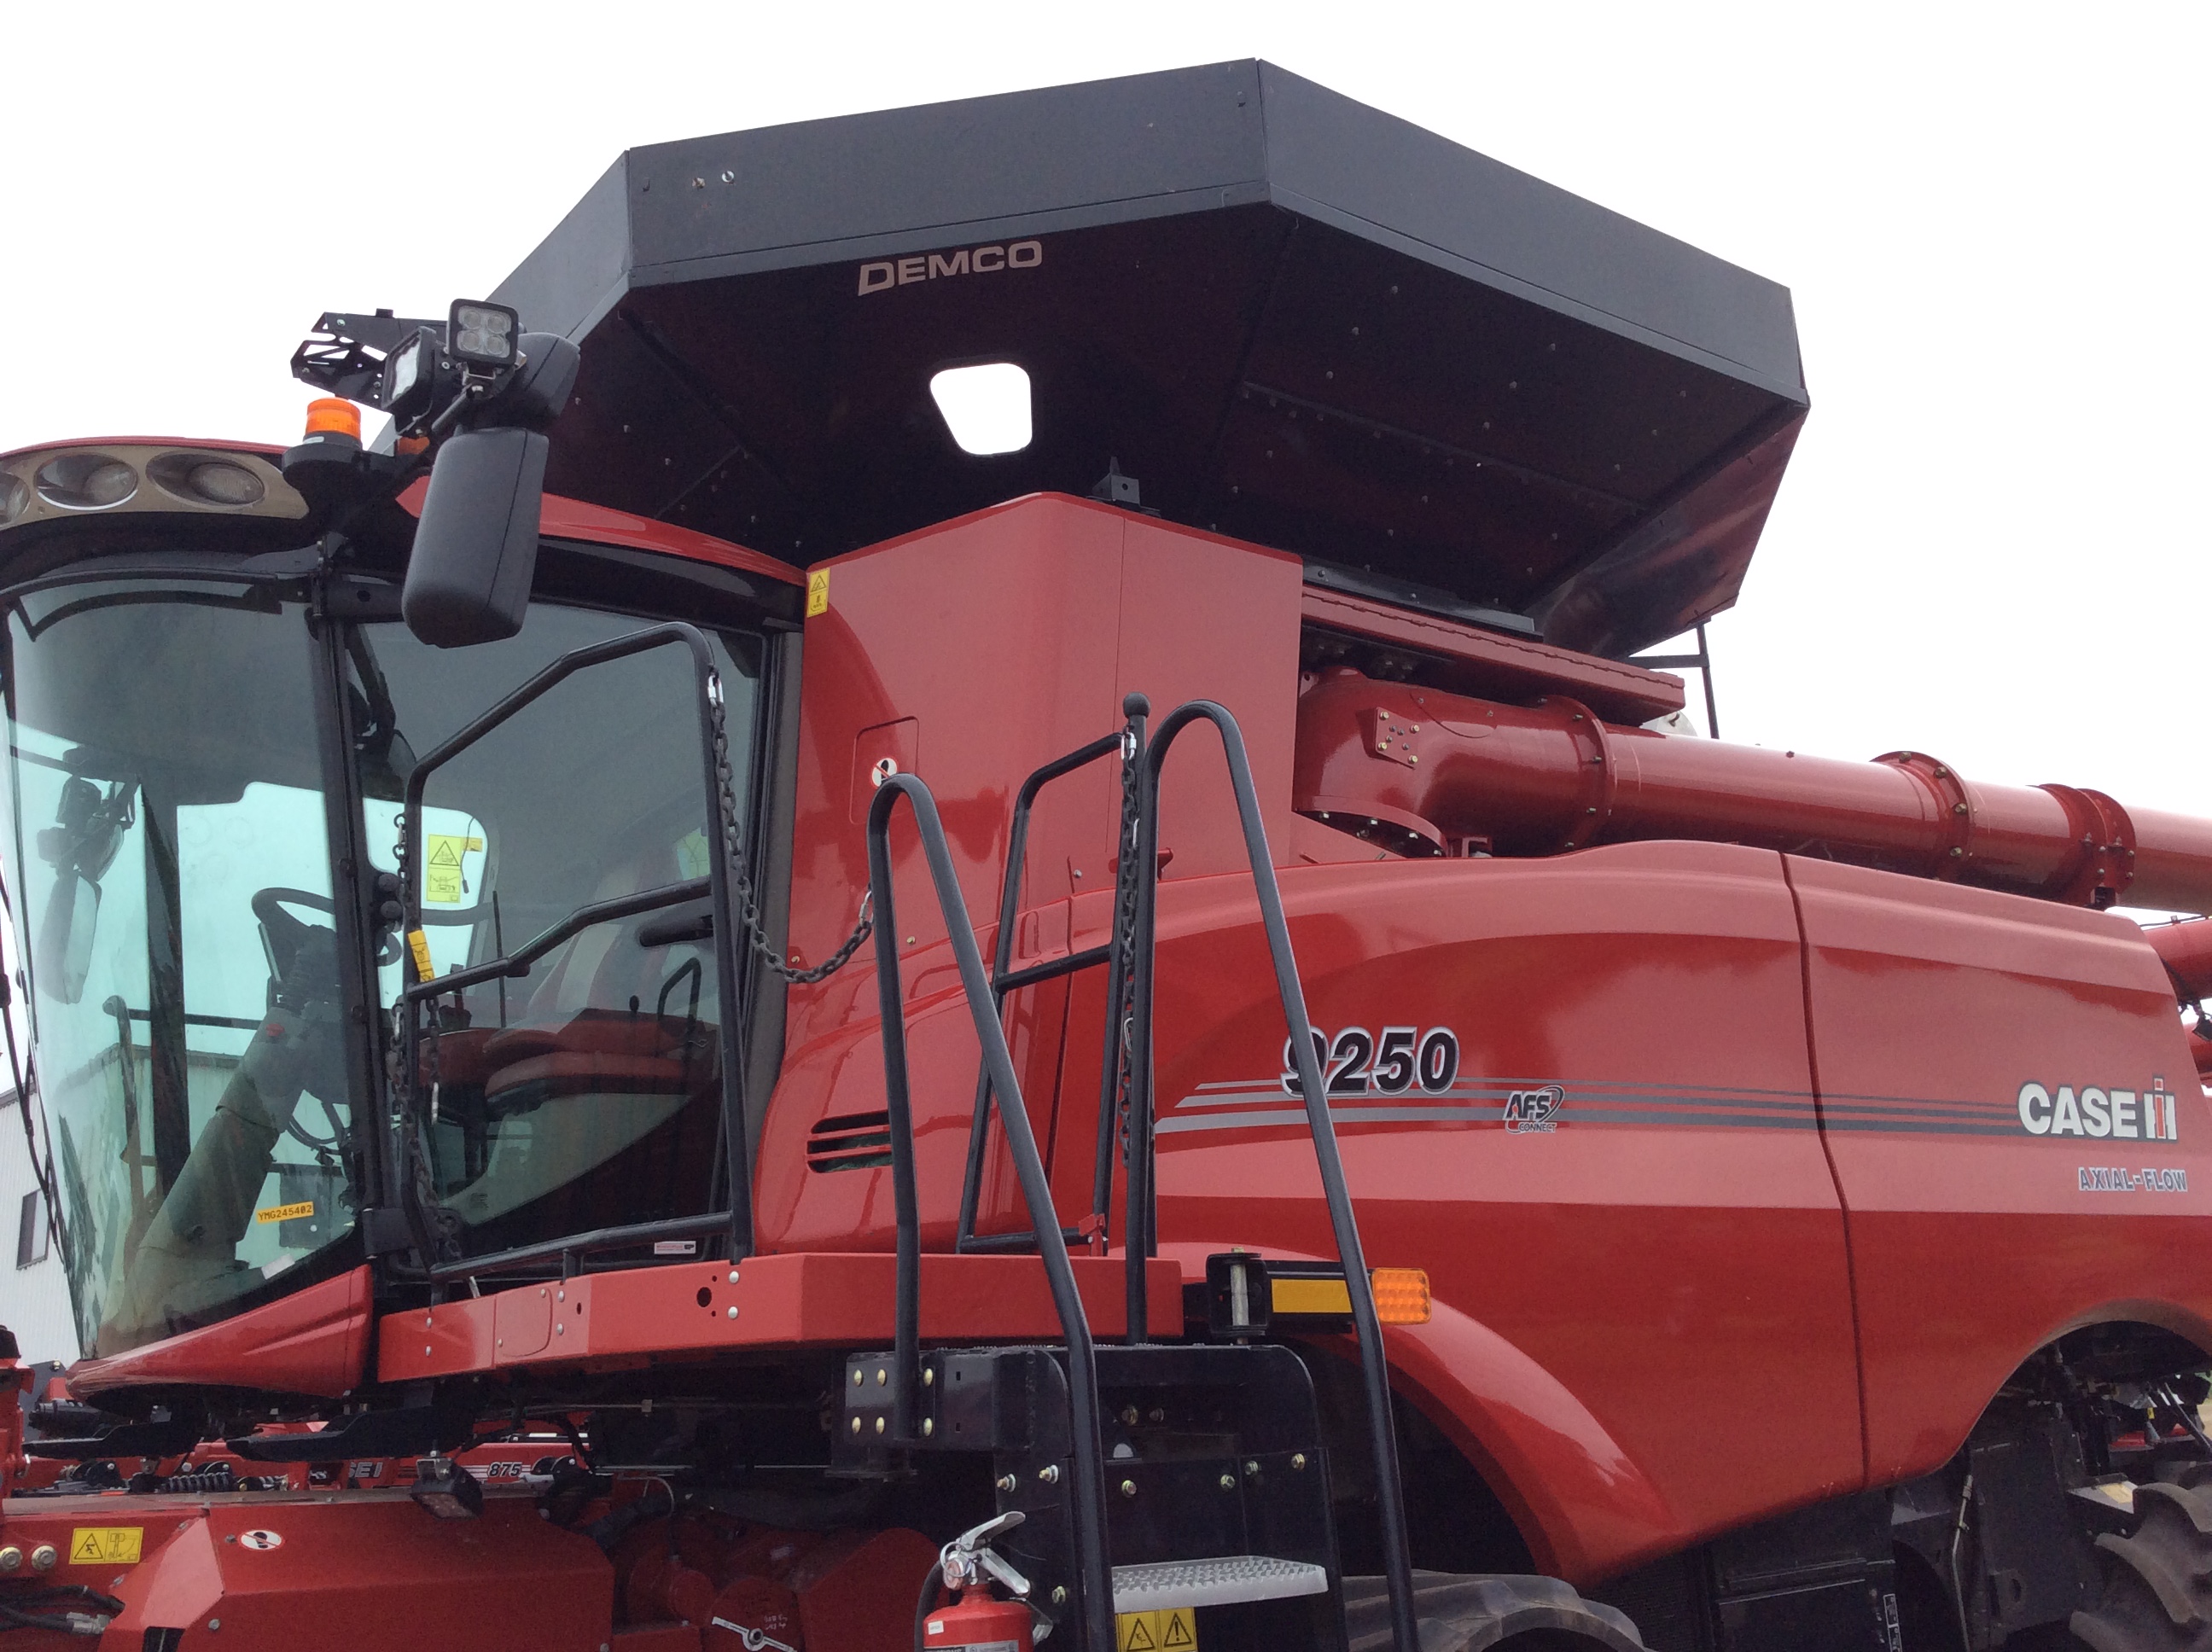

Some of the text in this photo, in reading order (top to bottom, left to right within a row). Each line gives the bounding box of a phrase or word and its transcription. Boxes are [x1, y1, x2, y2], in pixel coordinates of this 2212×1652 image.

[858, 241, 1042, 296] DEMCO
[1281, 1026, 1459, 1097] 9250
[1503, 1091, 1552, 1120] AFS
[2018, 1083, 2138, 1137] CASE
[1518, 1122, 1557, 1133] CONNECT
[2078, 1167, 2187, 1191] AXIAL-FLOW
[259, 1204, 312, 1221] YMG245402
[487, 1462, 522, 1477] 875
